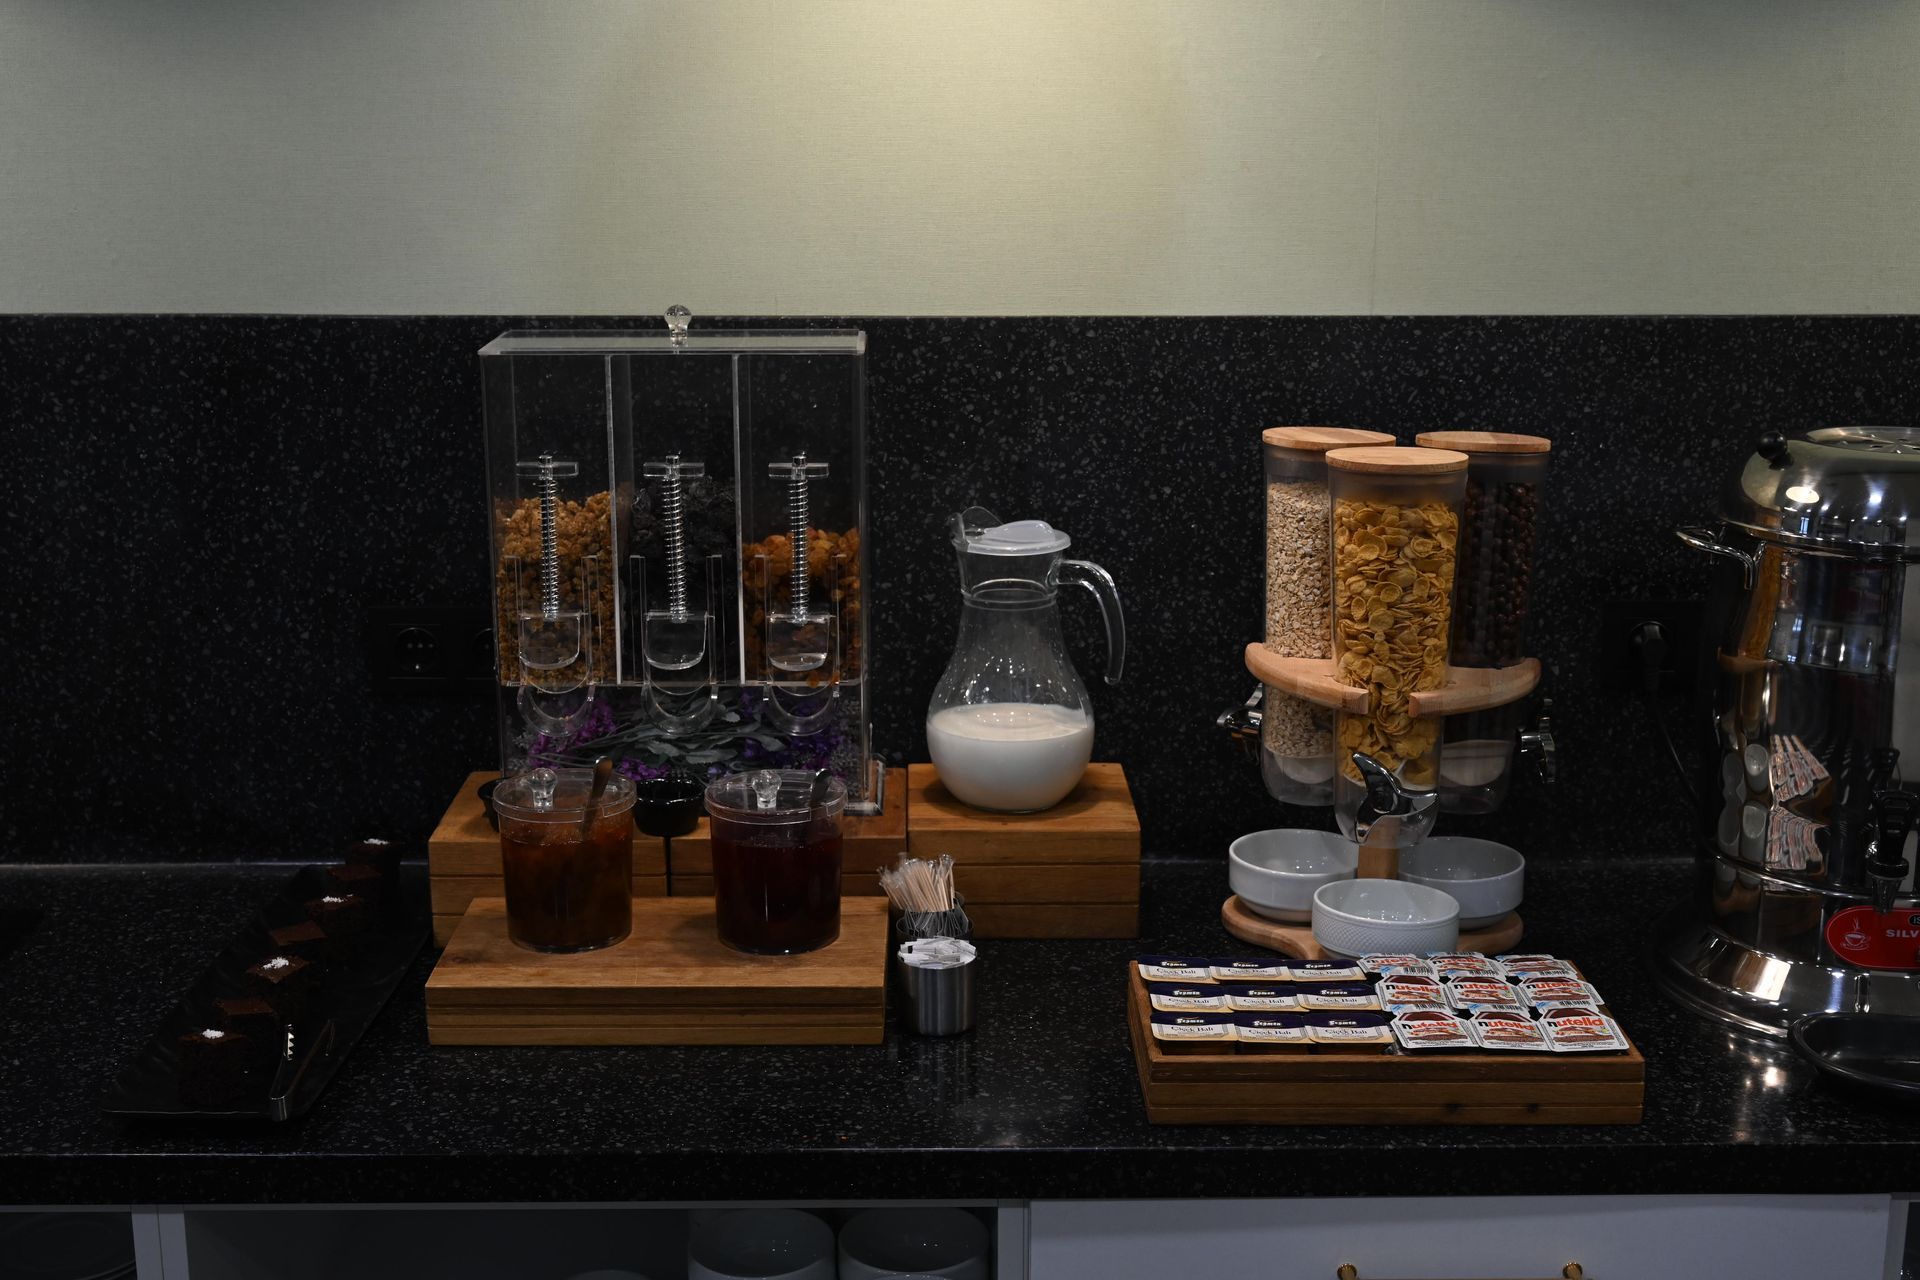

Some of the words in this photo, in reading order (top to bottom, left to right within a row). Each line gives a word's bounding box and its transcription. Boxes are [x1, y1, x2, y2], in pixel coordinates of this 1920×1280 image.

[1386, 984, 1441, 995] nutella
[1454, 983, 1510, 991] nutella
[1526, 982, 1582, 991] nutella
[1402, 1021, 1458, 1030] nutella
[1479, 1021, 1536, 1031] nutella
[1547, 1017, 1604, 1028] nutella
